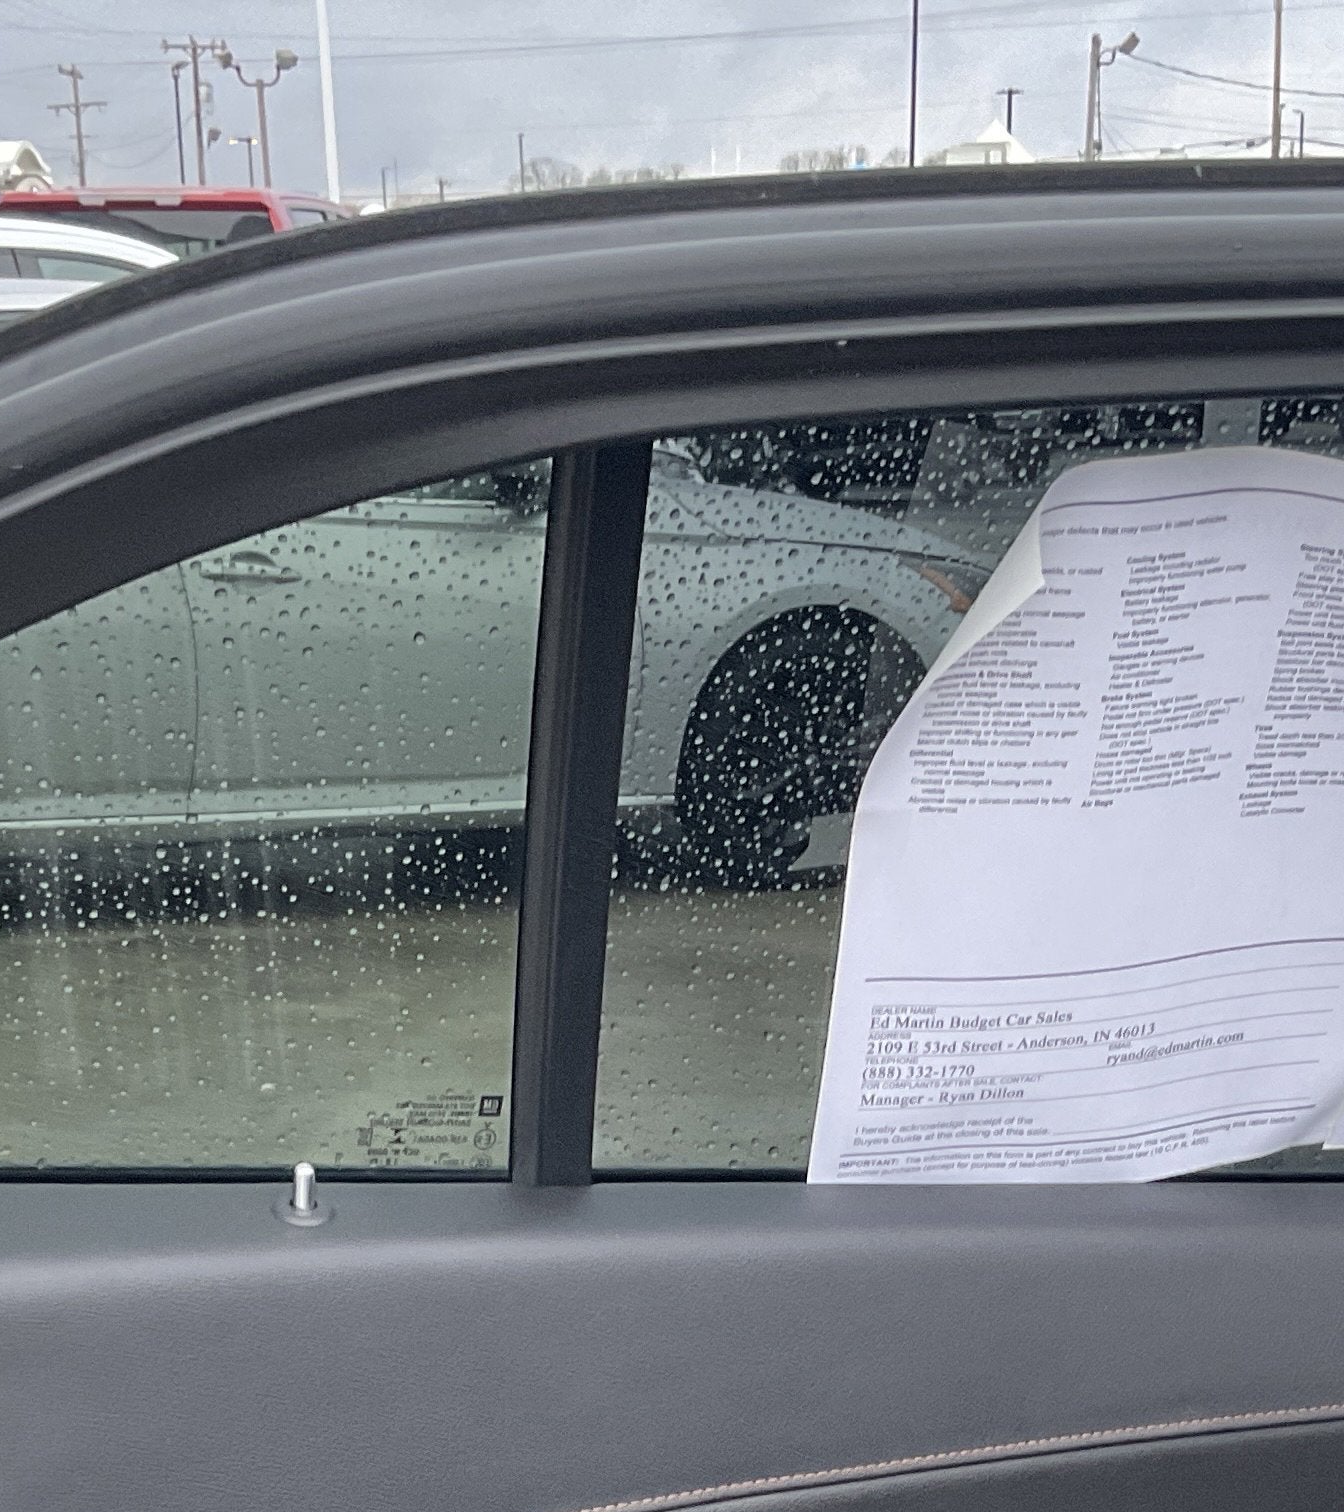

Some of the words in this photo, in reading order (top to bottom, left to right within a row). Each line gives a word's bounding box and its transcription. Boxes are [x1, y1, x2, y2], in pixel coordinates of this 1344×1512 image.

[870, 1016, 889, 1029] Ed
[894, 1015, 944, 1029] Martin
[950, 1013, 1001, 1031] Budget
[1006, 1013, 1032, 1026] Car
[1035, 1010, 1073, 1024] Sales
[867, 1041, 902, 1054] 2109
[907, 1041, 918, 1053] E
[922, 1040, 956, 1054] 53rd
[961, 1039, 1002, 1053] Street
[1017, 1034, 1088, 1050] Anderson,
[1093, 1030, 1110, 1042] IN
[1114, 1022, 1155, 1039] 46013
[1106, 1031, 1244, 1066] ryand@edmartin.com
[862, 1066, 902, 1081] (888)
[906, 1065, 975, 1080] 332-1770
[860, 1093, 924, 1108] Manager
[939, 1091, 975, 1105] Ryan
[980, 1087, 1024, 1100] Dillon
